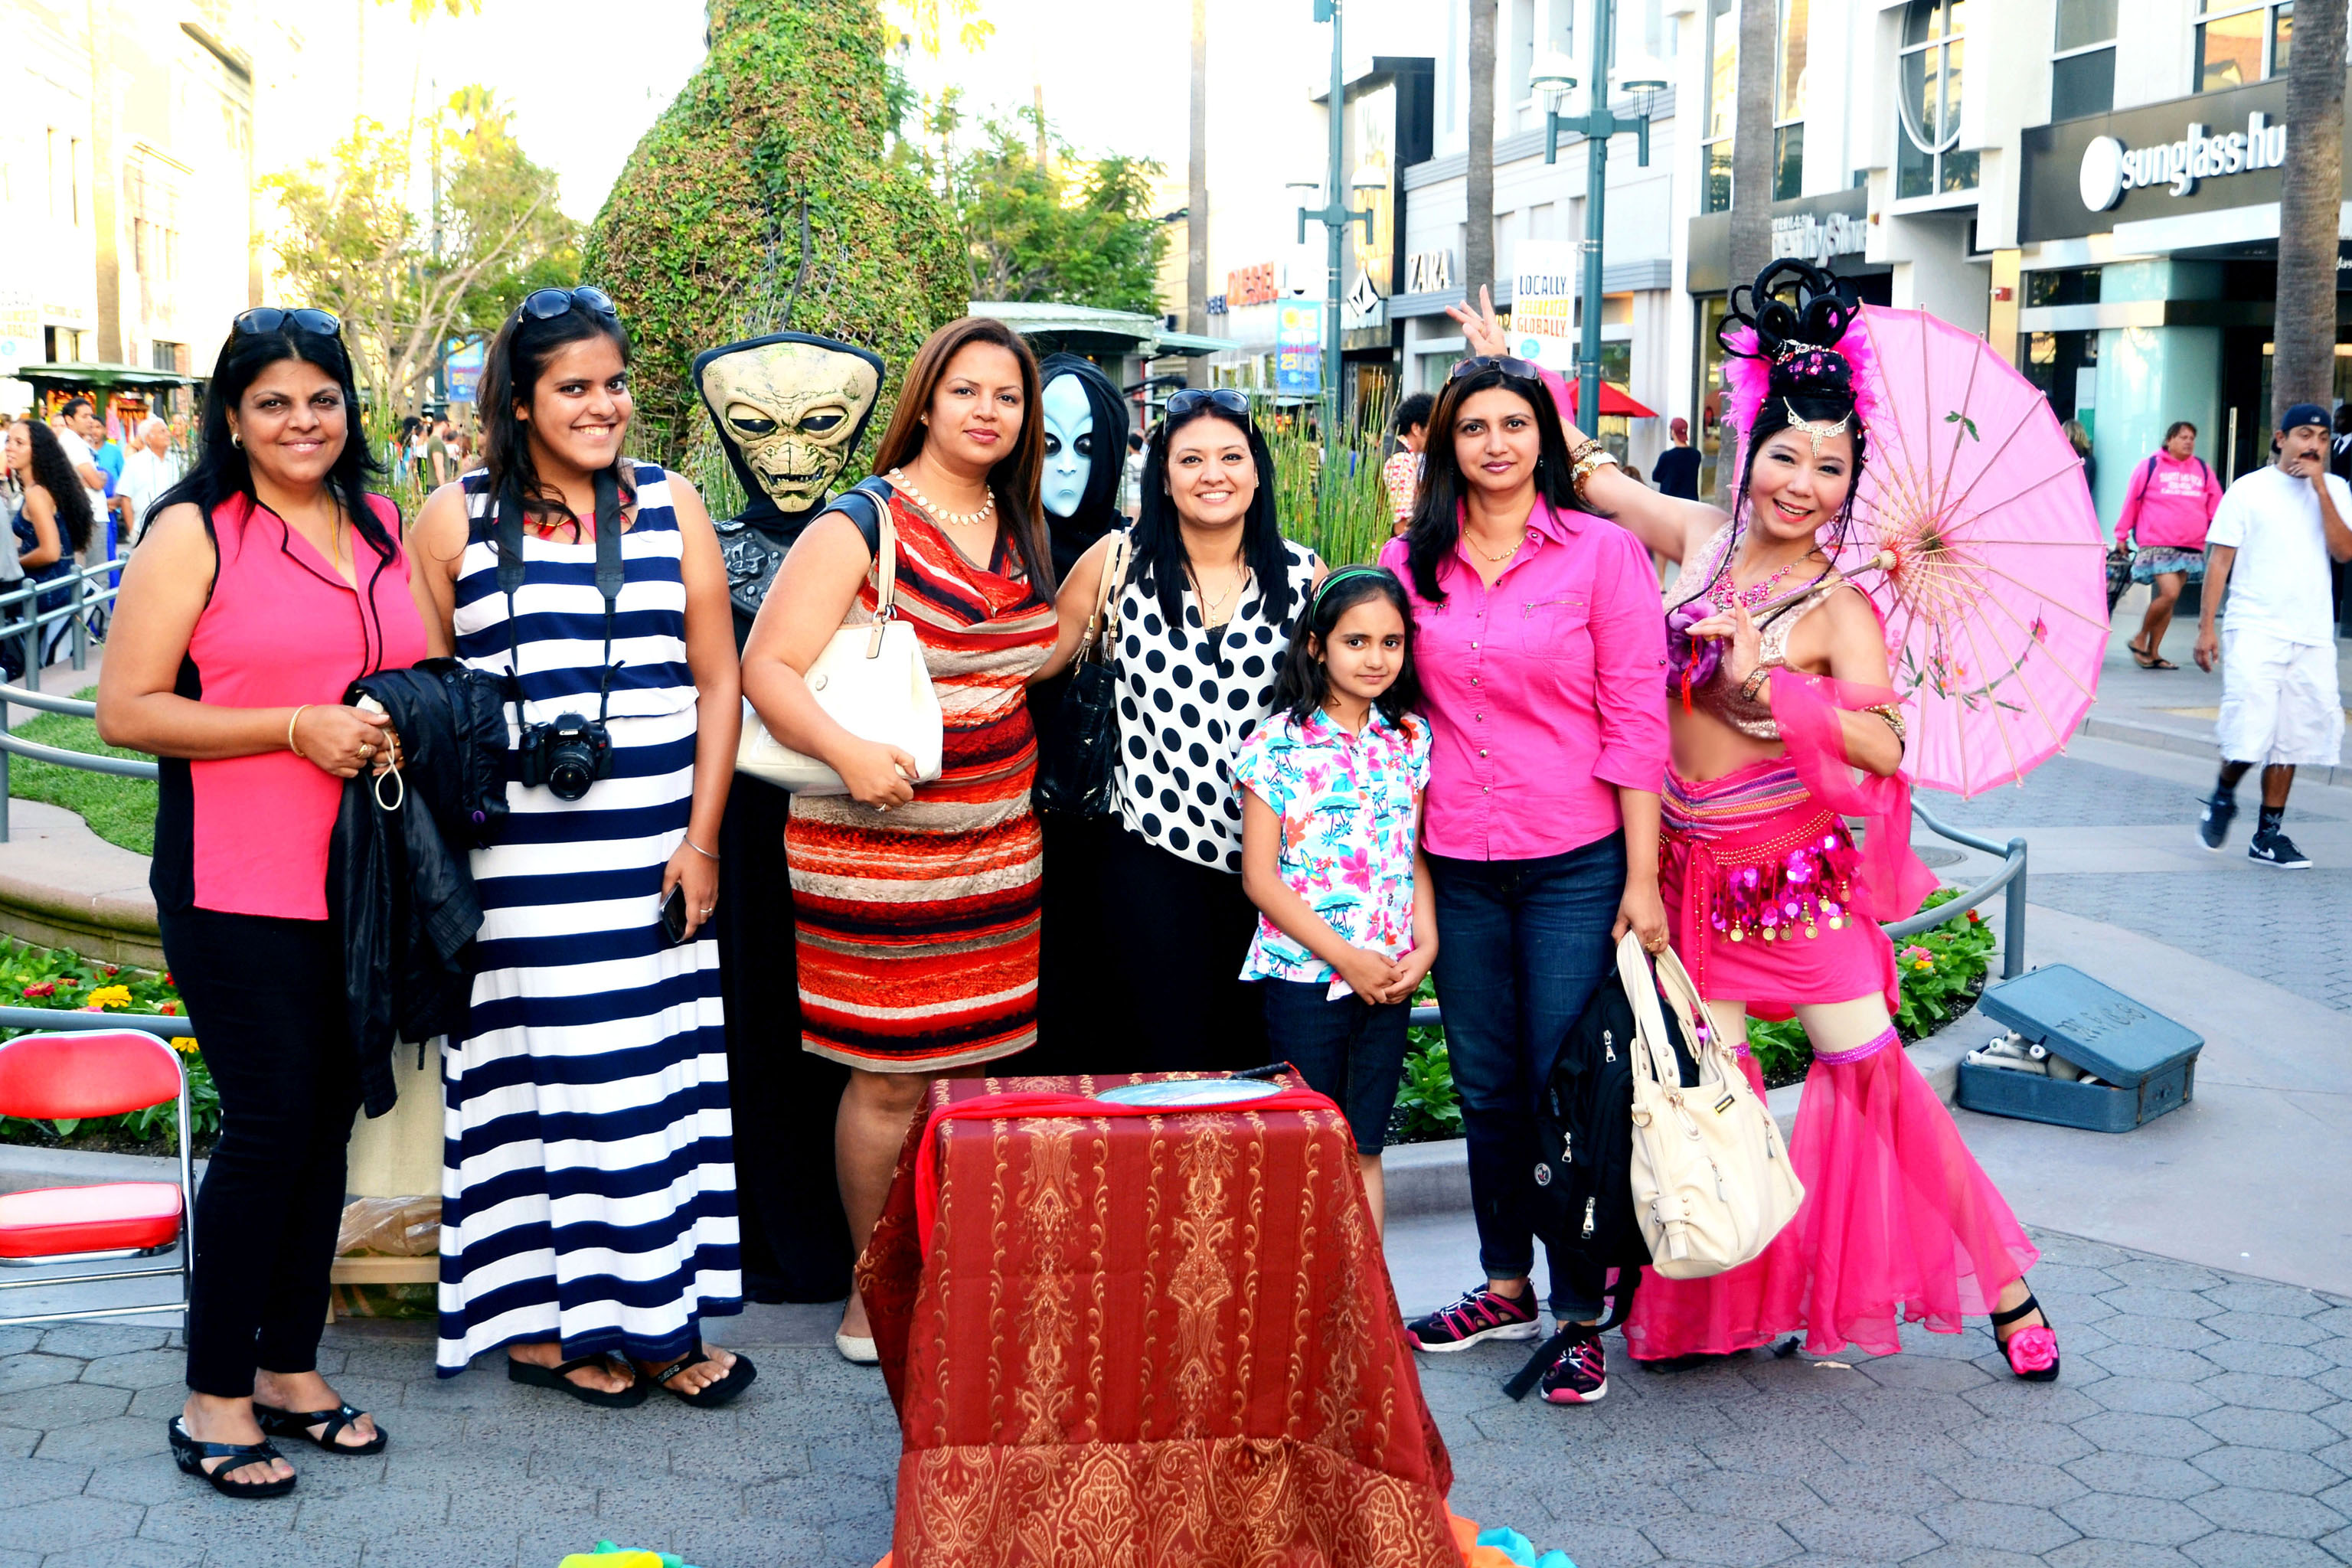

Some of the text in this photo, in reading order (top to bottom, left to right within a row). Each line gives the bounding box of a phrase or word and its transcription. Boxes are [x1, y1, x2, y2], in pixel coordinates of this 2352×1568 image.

[2121, 111, 2288, 197] sunglass hu
[1407, 249, 1452, 294] ZARA
[1226, 261, 1279, 307] DIESEL
[1519, 275, 1569, 296] LOCALLY.
[1518, 299, 1569, 317] CELEBRATED
[1517, 316, 1569, 338] GLOBALLY.
[1280, 353, 1298, 371] 25
